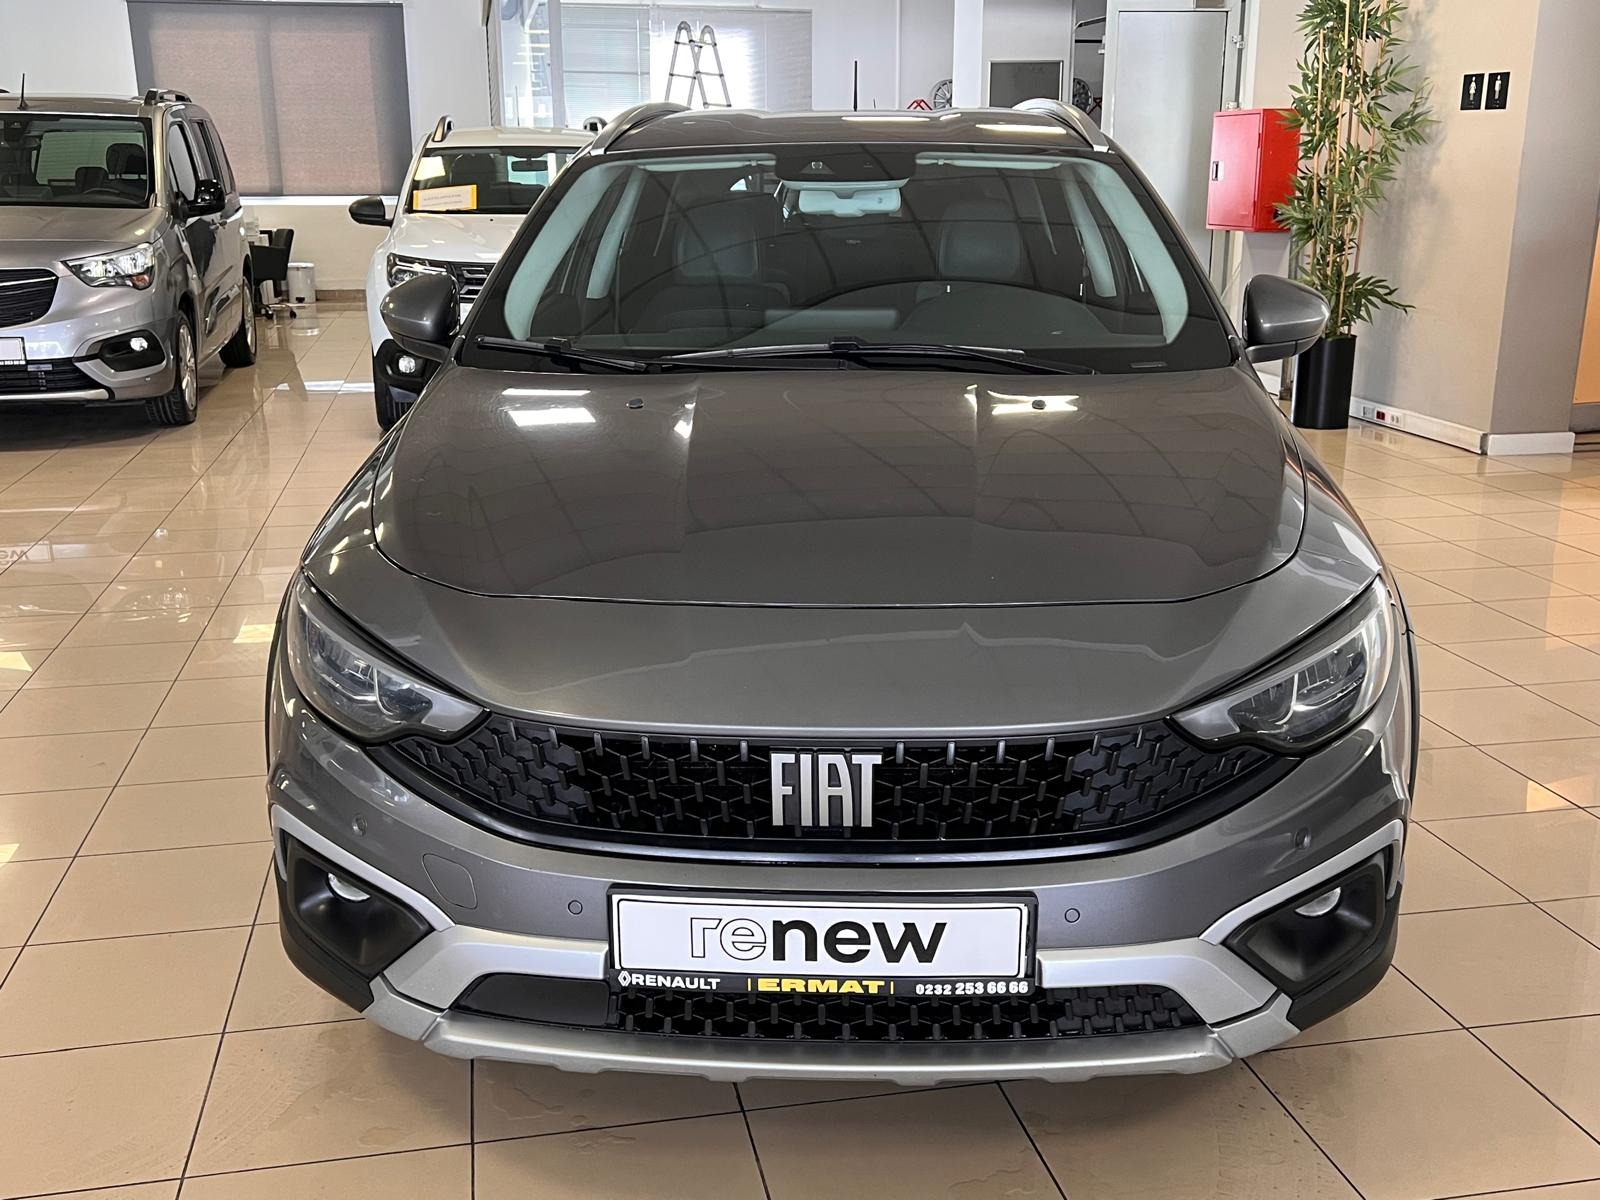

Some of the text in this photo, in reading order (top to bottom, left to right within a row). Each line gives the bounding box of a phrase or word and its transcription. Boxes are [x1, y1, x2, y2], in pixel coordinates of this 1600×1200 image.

[770, 753, 883, 828] FIAT
[690, 917, 948, 964] renew
[631, 973, 721, 990] RENAULT
[757, 978, 886, 994] ERMAT
[915, 983, 952, 996] 0232
[955, 982, 985, 995] 253
